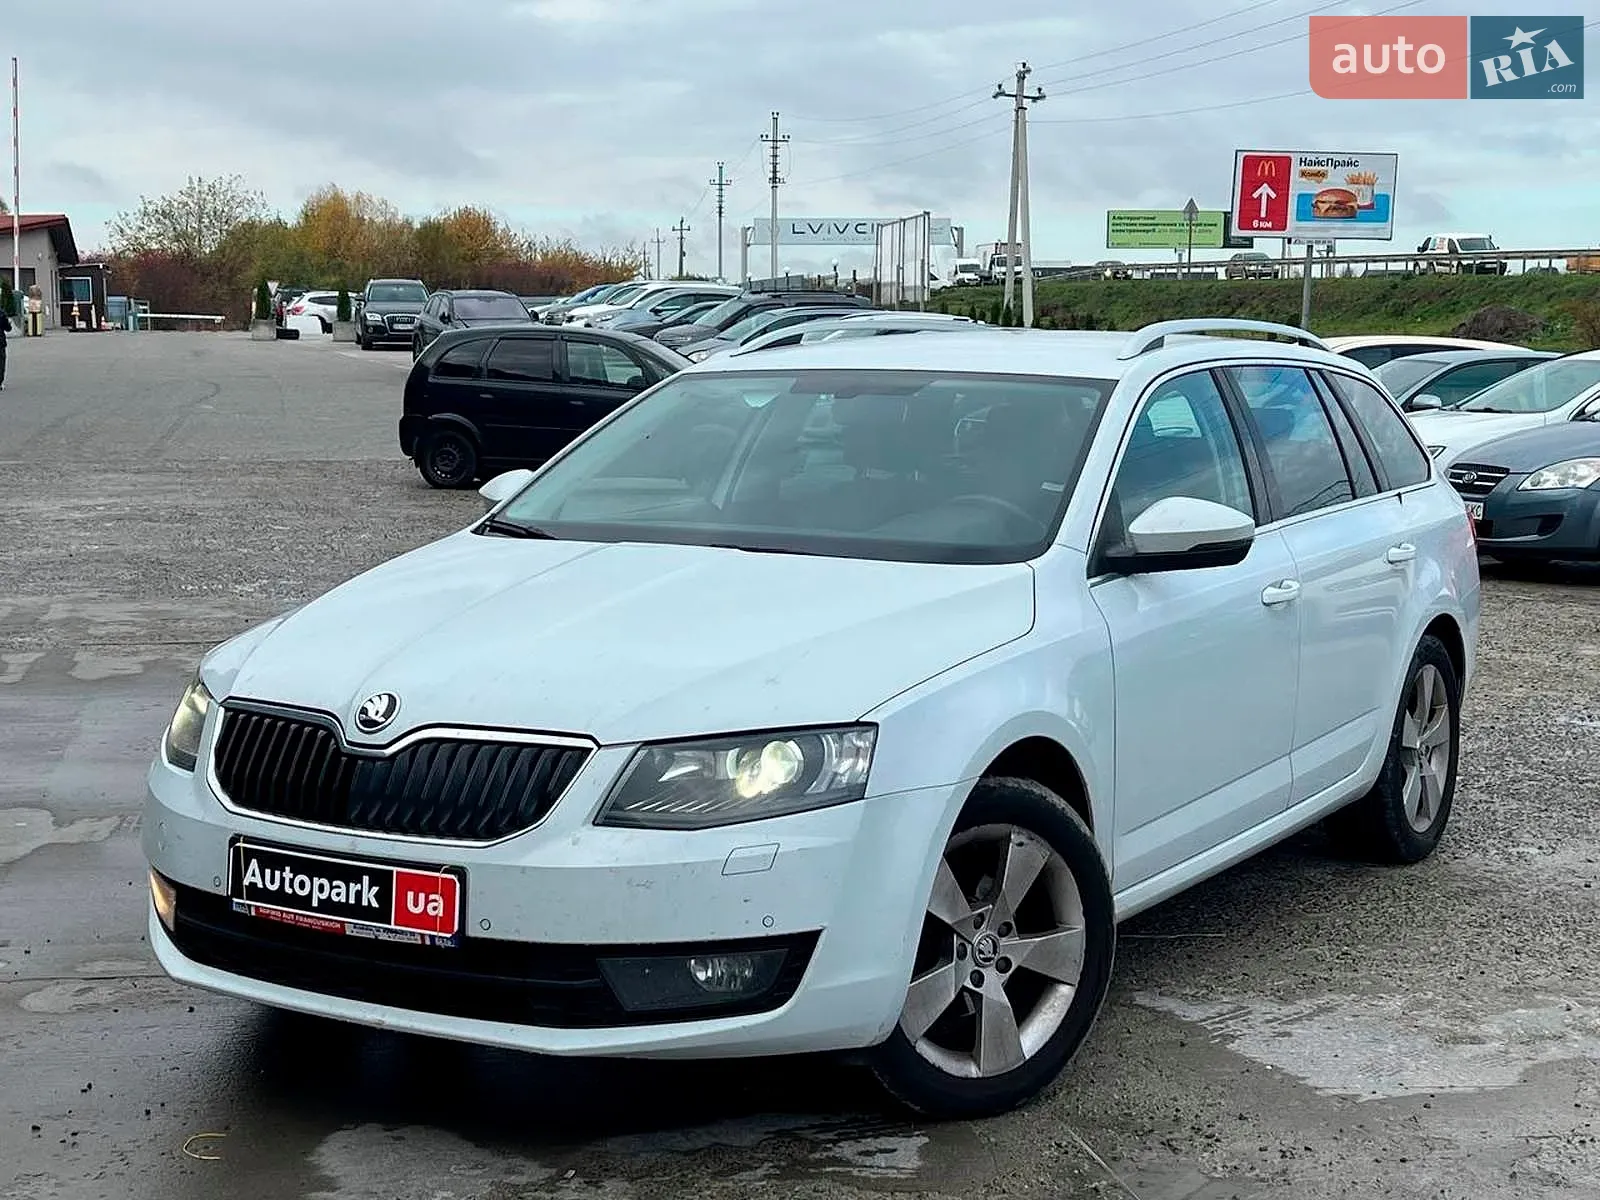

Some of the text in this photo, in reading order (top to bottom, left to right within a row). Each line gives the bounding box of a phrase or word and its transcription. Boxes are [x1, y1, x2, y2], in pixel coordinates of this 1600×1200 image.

[1299, 156, 1360, 169] НайсПрайс
[1252, 220, 1259, 228] 6
[243, 858, 380, 908] Autopark
[406, 889, 444, 917] ua
